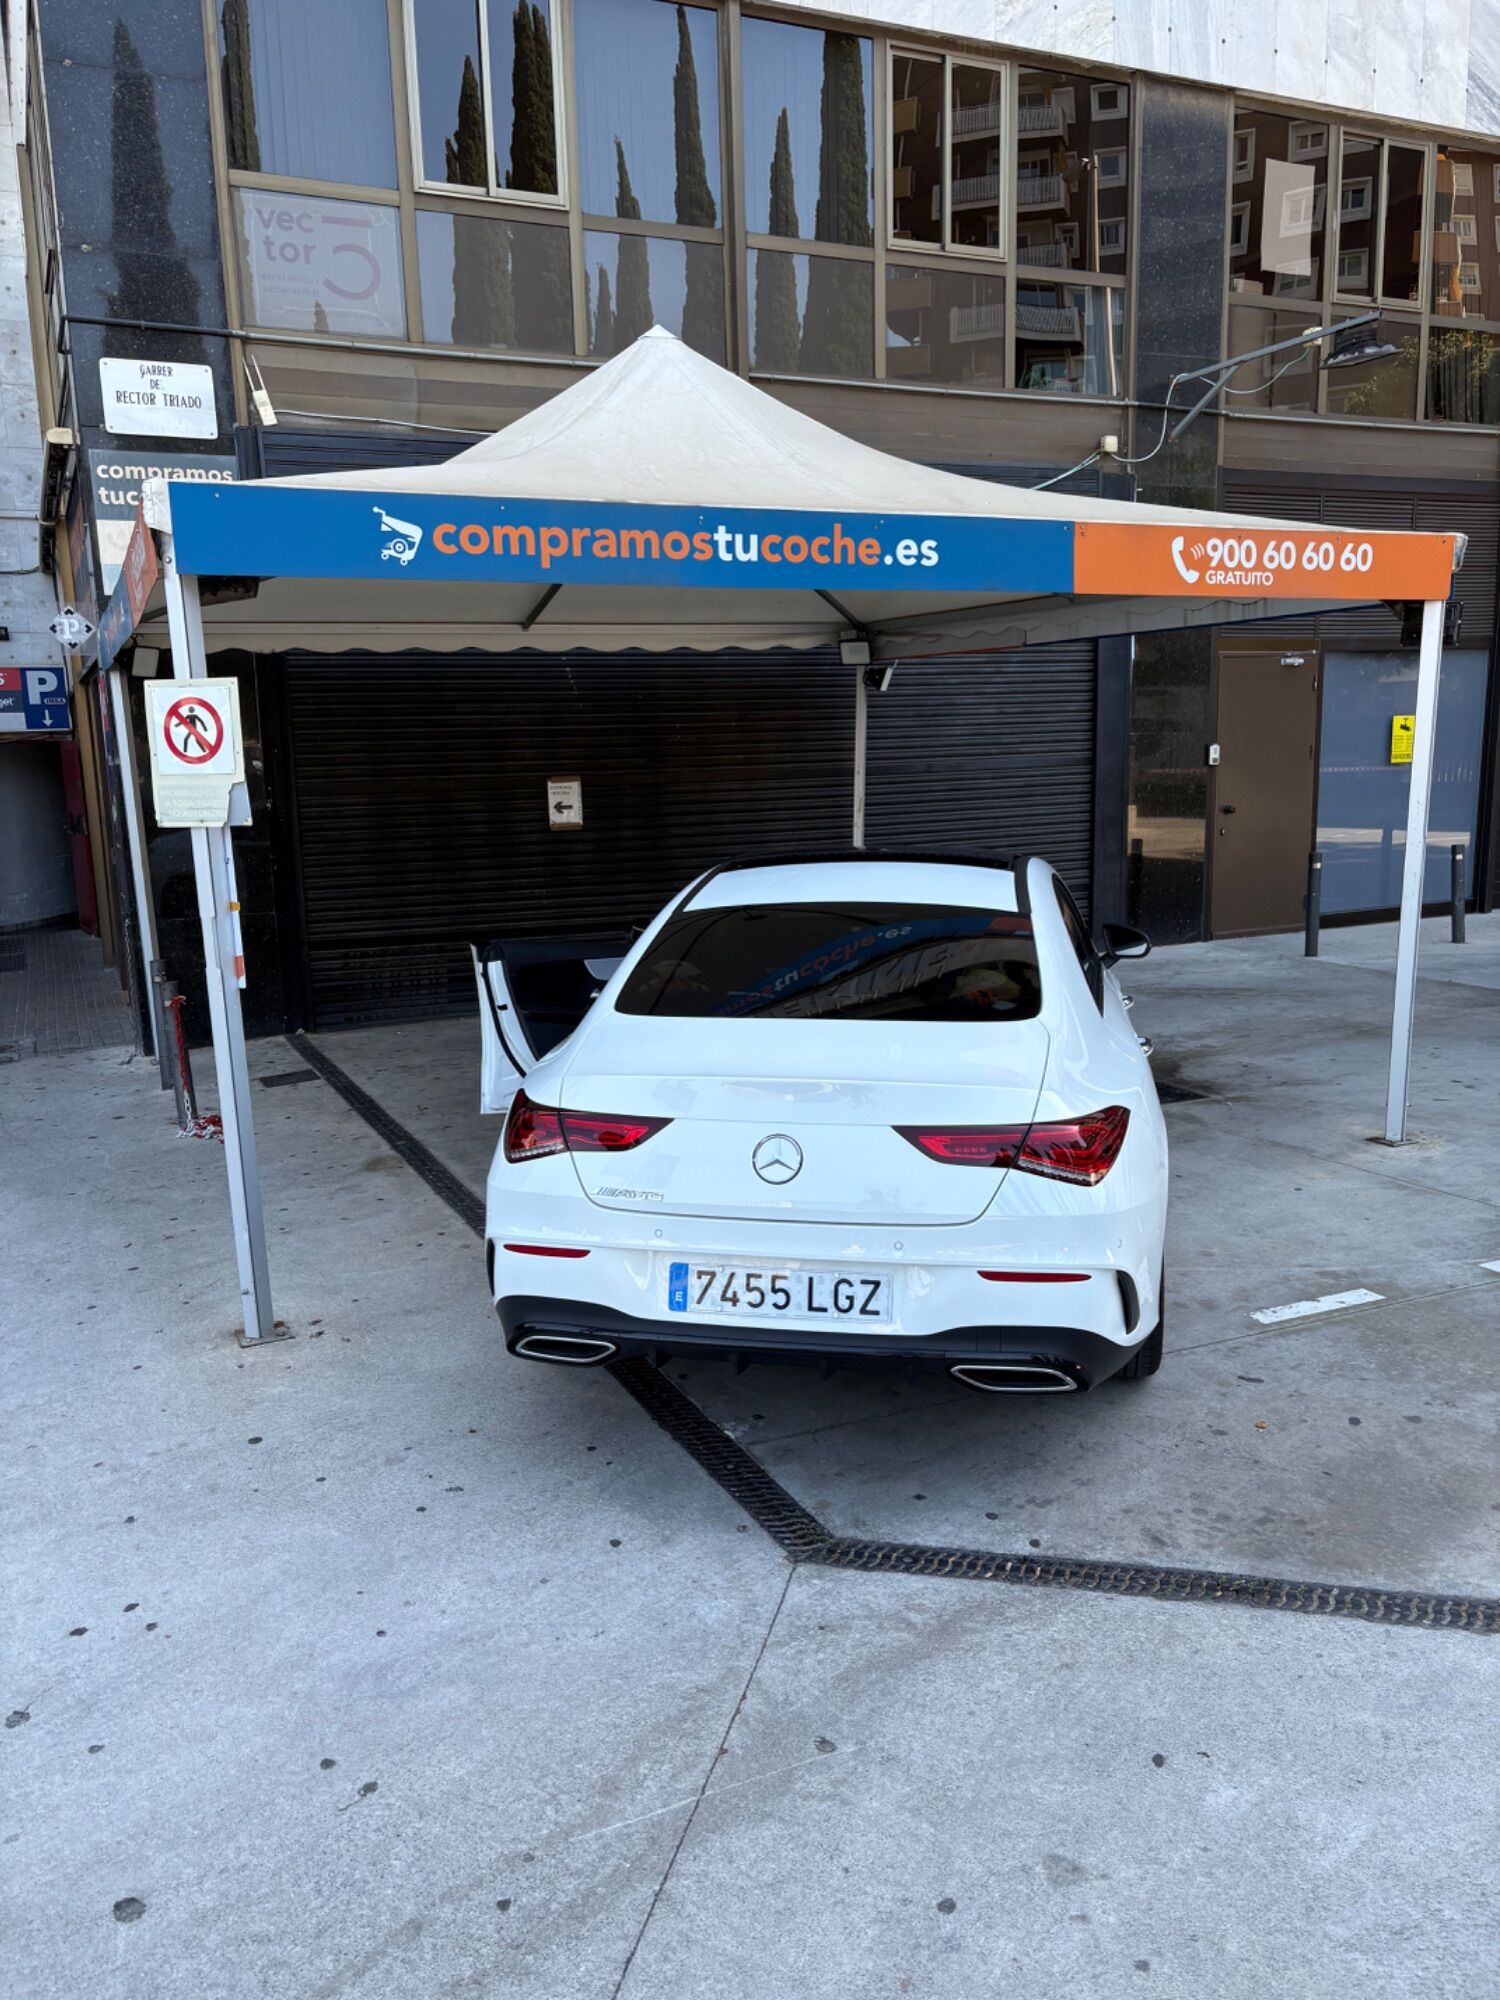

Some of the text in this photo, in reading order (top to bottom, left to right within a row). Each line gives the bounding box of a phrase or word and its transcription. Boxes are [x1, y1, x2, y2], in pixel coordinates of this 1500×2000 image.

[255, 208, 314, 233] vec
[262, 235, 316, 265] tor
[116, 390, 157, 405] RECTOR
[96, 464, 233, 482] compramos
[98, 486, 141, 506] tuc
[432, 522, 940, 569] compramostucoche.es
[1205, 537, 1373, 572] 900 60 60 60
[1205, 570, 1273, 586] GRATUITO
[62, 618, 80, 639] P
[25, 670, 58, 705] P
[675, 1269, 881, 1316] E 7455 LGZ
